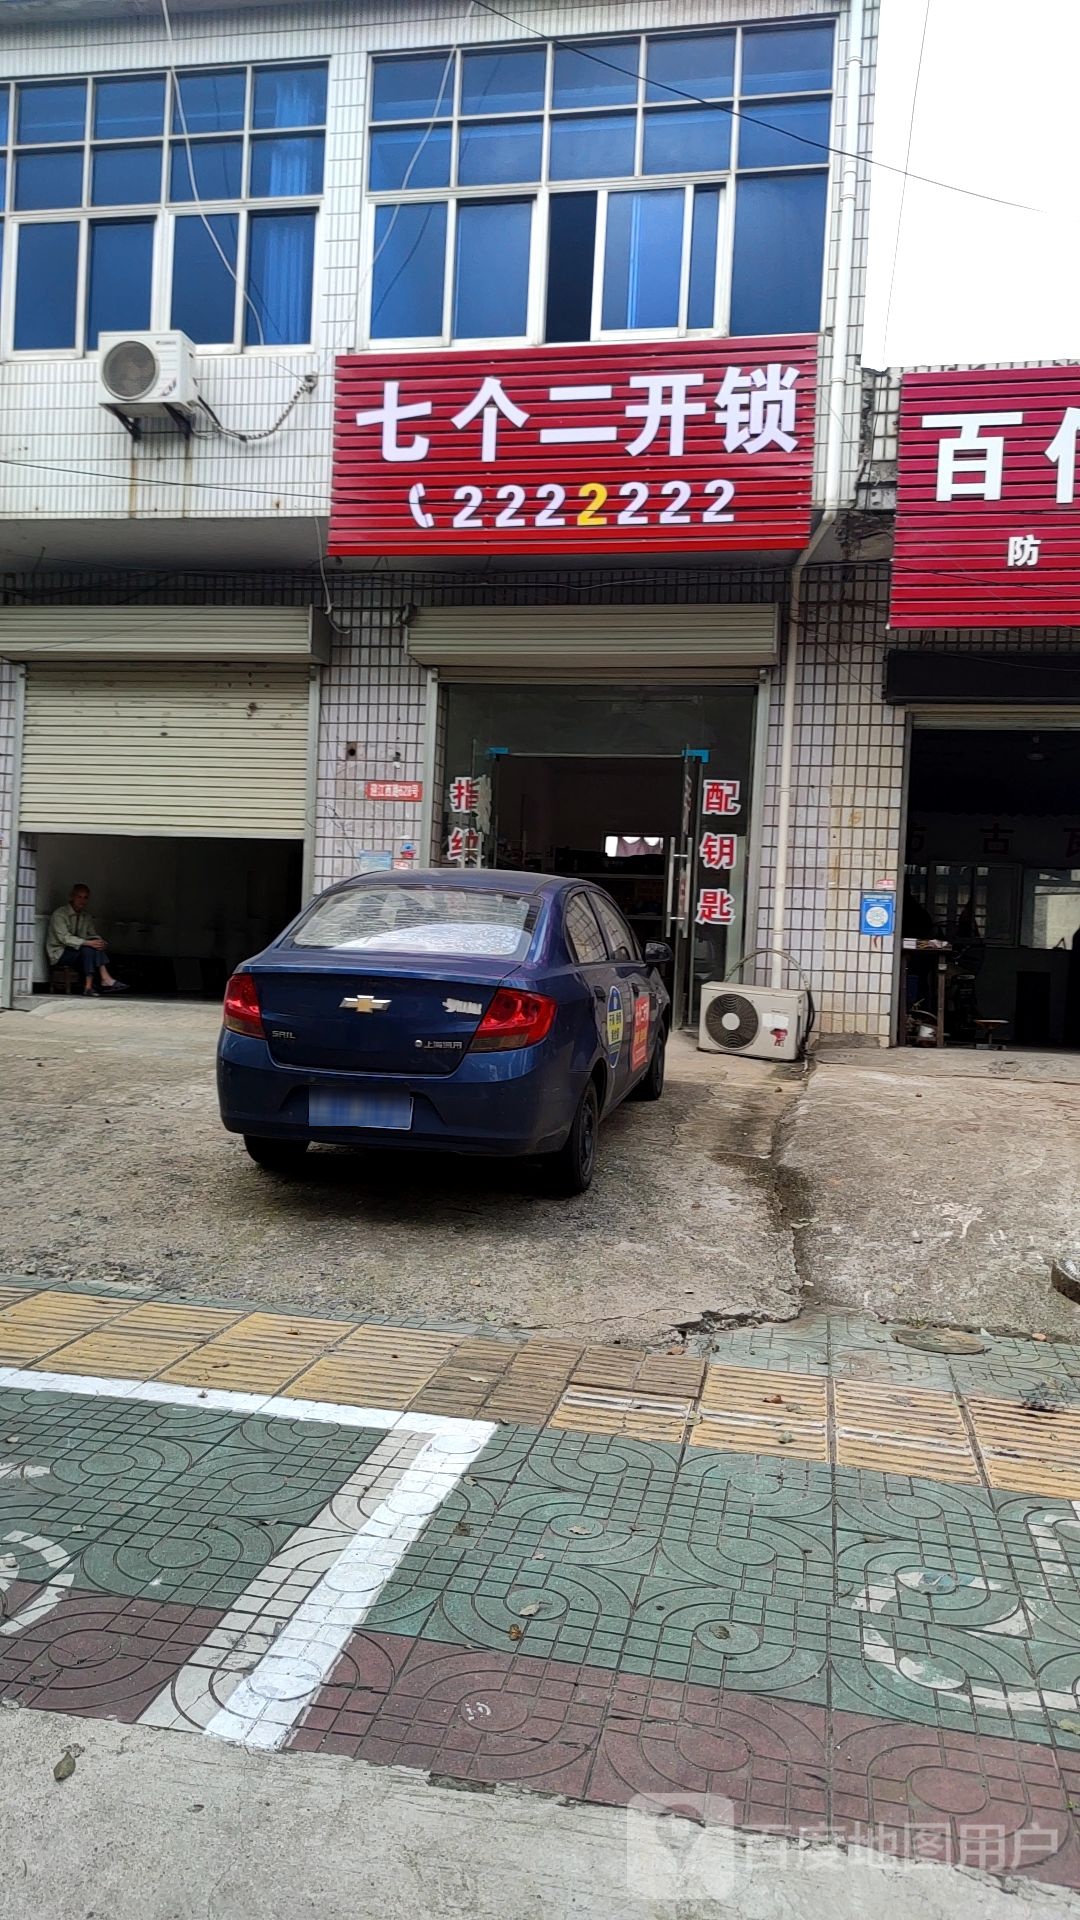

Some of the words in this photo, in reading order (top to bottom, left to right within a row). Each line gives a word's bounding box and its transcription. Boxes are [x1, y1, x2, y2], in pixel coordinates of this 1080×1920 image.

[356, 363, 801, 464] 七个二开锁
[452, 479, 736, 528] 2222222
[1007, 534, 1041, 567] 防
[696, 779, 741, 925] 配钥匙
[271, 1030, 297, 1039] SAIL
